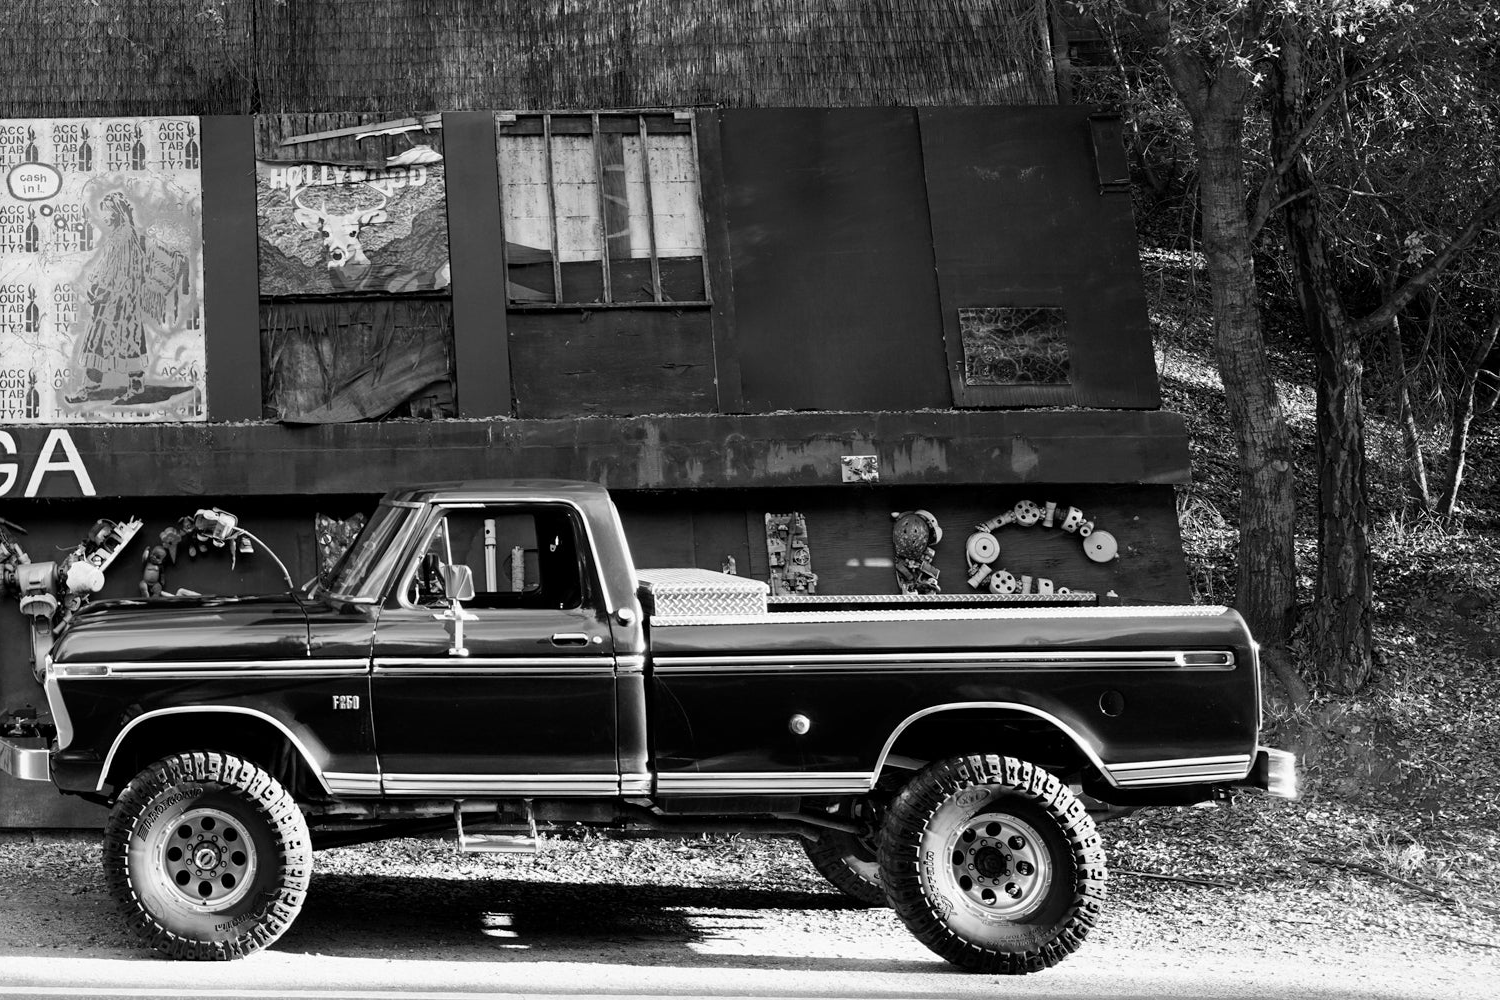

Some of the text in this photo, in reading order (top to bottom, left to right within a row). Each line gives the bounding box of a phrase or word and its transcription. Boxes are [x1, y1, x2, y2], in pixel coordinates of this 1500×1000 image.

[0, 126, 25, 135] ACC
[53, 124, 78, 134] ACC
[106, 123, 131, 133] ACC
[159, 122, 184, 132] ACC
[0, 135, 25, 145] OUN
[52, 134, 78, 143] OUN
[106, 133, 131, 142] OUN
[158, 132, 184, 141] OUN
[0, 145, 25, 154] TAB
[53, 143, 78, 153] TAB
[106, 142, 131, 152] TAB
[159, 141, 184, 151] TAB
[55, 153, 76, 162] ILI
[108, 152, 129, 162] ILI
[161, 151, 182, 160] ILI
[106, 162, 130, 171] TY?
[159, 160, 184, 170] TY?
[20, 173, 47, 182] cash
[270, 164, 427, 190] HOLLYWOOD
[0, 205, 25, 215] ACC
[54, 204, 79, 213] ACC
[0, 214, 25, 224] OUN
[0, 224, 25, 234] TAB
[1, 234, 22, 243] ILI
[56, 233, 76, 242] ILI
[0, 244, 24, 254] TY?
[54, 242, 78, 252] TY?
[0, 284, 25, 294] ACC
[0, 294, 25, 303] OUN
[0, 304, 25, 313] TAB
[1, 314, 22, 323] ILI
[0, 324, 24, 333] TY?
[0, 370, 25, 379] ACC
[0, 379, 25, 389] OUN
[0, 389, 25, 398] TAB
[1, 399, 23, 409] ILI
[0, 409, 24, 419] TY?
[332, 695, 359, 709] F250
